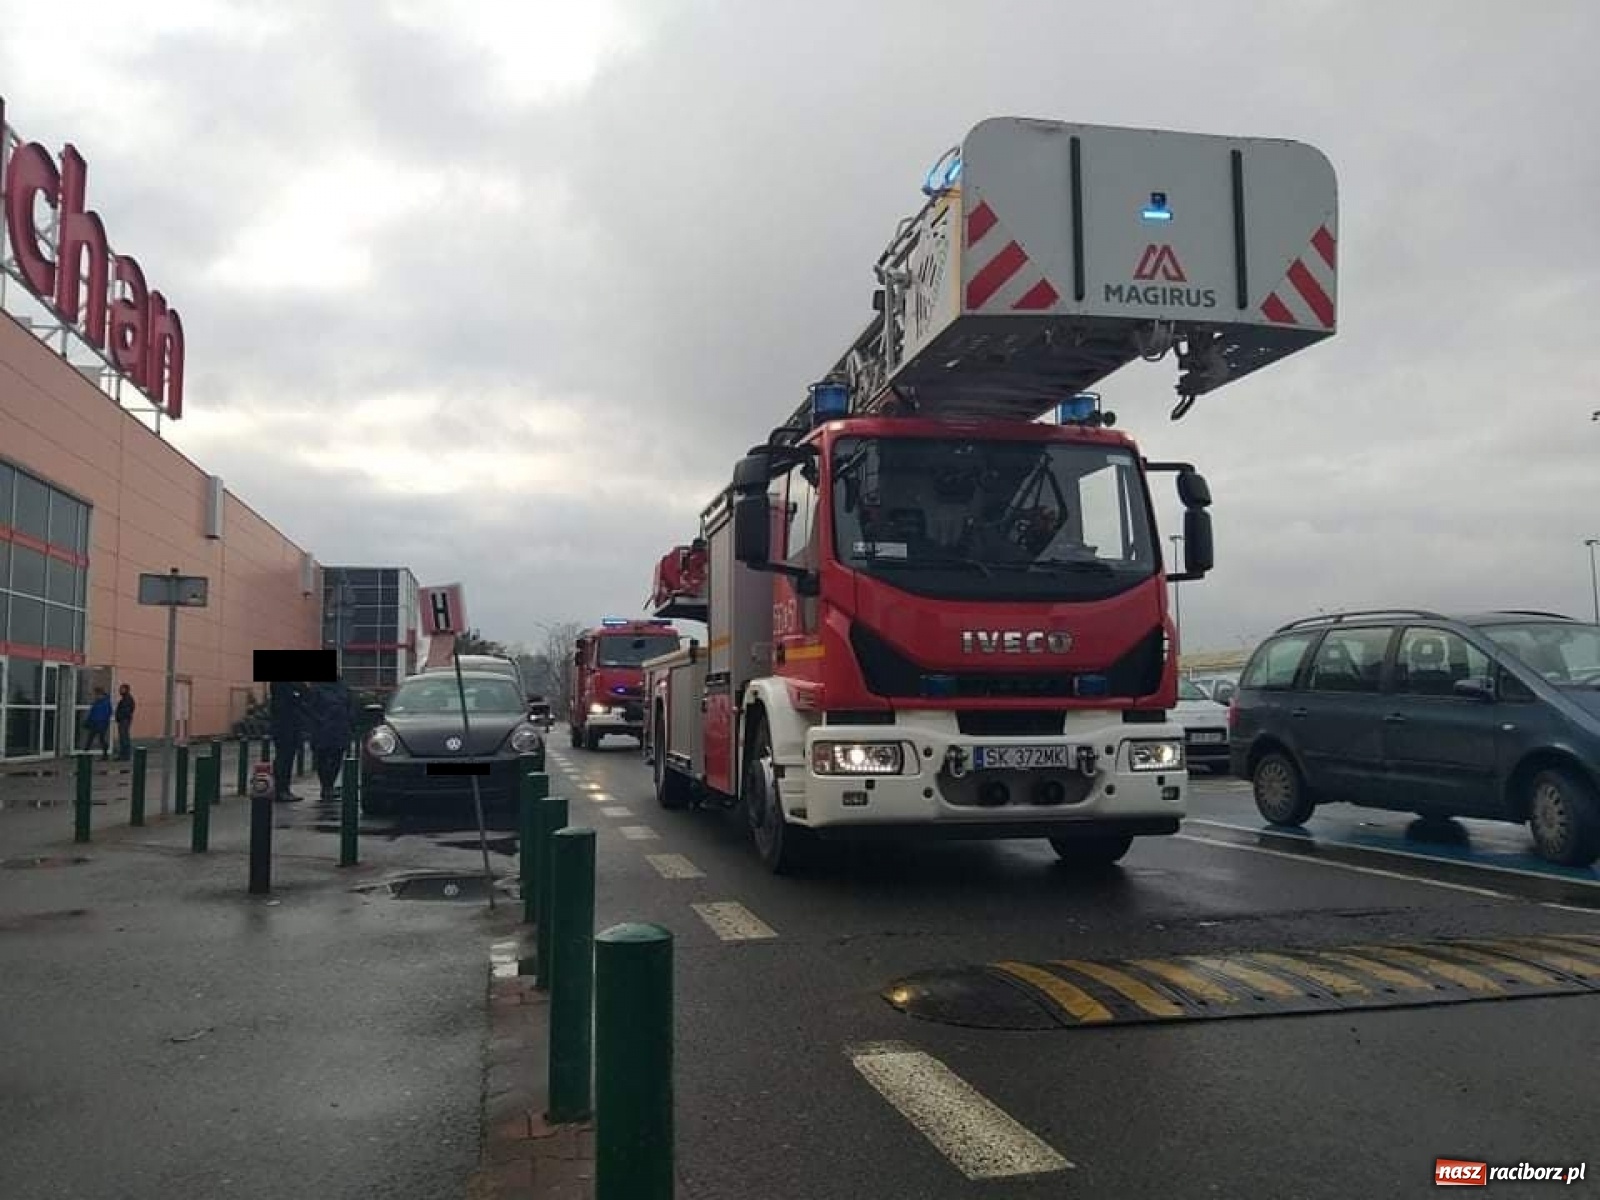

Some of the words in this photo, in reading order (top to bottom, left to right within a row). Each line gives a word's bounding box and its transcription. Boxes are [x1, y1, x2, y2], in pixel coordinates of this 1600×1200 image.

[0, 95, 185, 419] chan
[1104, 283, 1216, 307] MAGIRUS
[431, 592, 451, 629] H
[962, 630, 1073, 654] IVECO
[986, 748, 1009, 766] SK
[1014, 747, 1065, 766] 372MK
